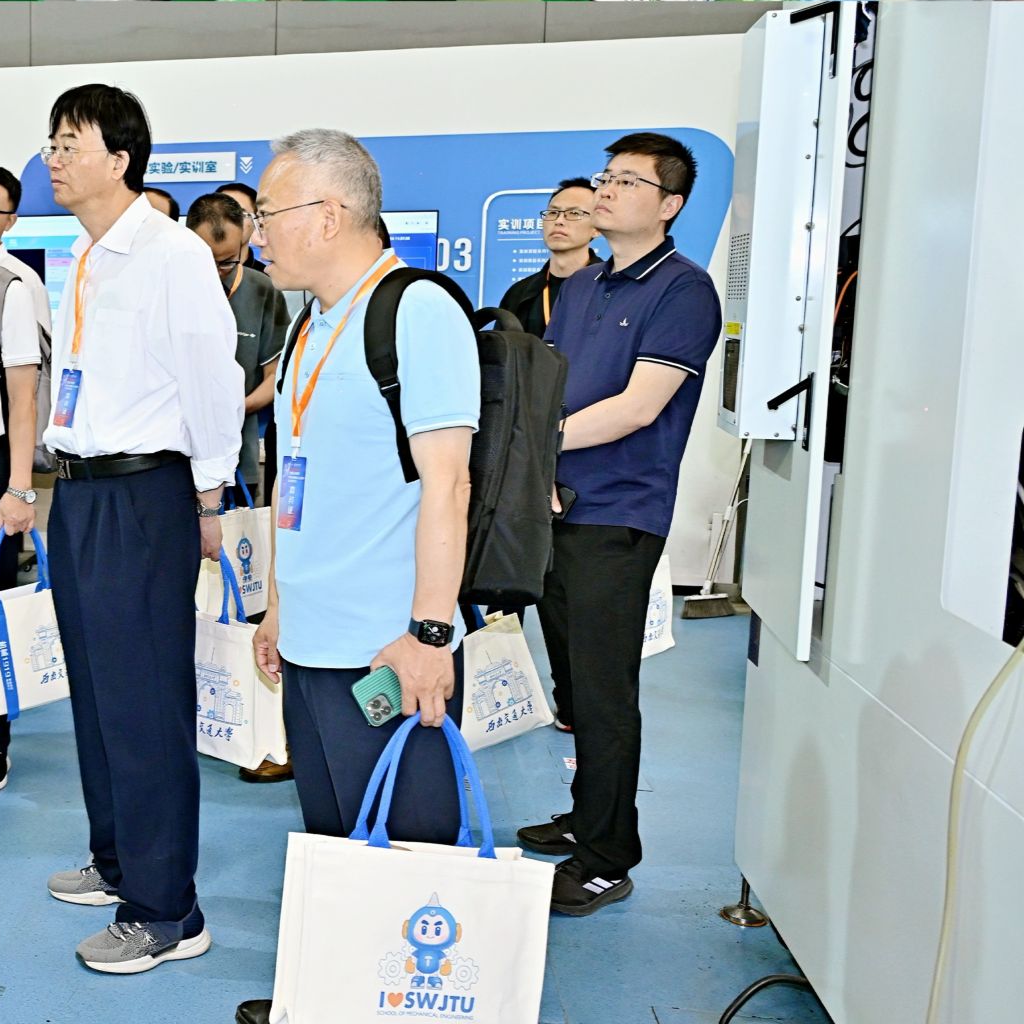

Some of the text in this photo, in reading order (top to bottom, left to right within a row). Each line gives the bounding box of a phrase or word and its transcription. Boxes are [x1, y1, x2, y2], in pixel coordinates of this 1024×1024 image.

[144, 161, 217, 174] 实验/实训室
[497, 218, 544, 230] 实训项目
[437, 237, 472, 272] 03
[242, 581, 262, 594] SWJTU
[379, 991, 475, 1013] I SWJTU
